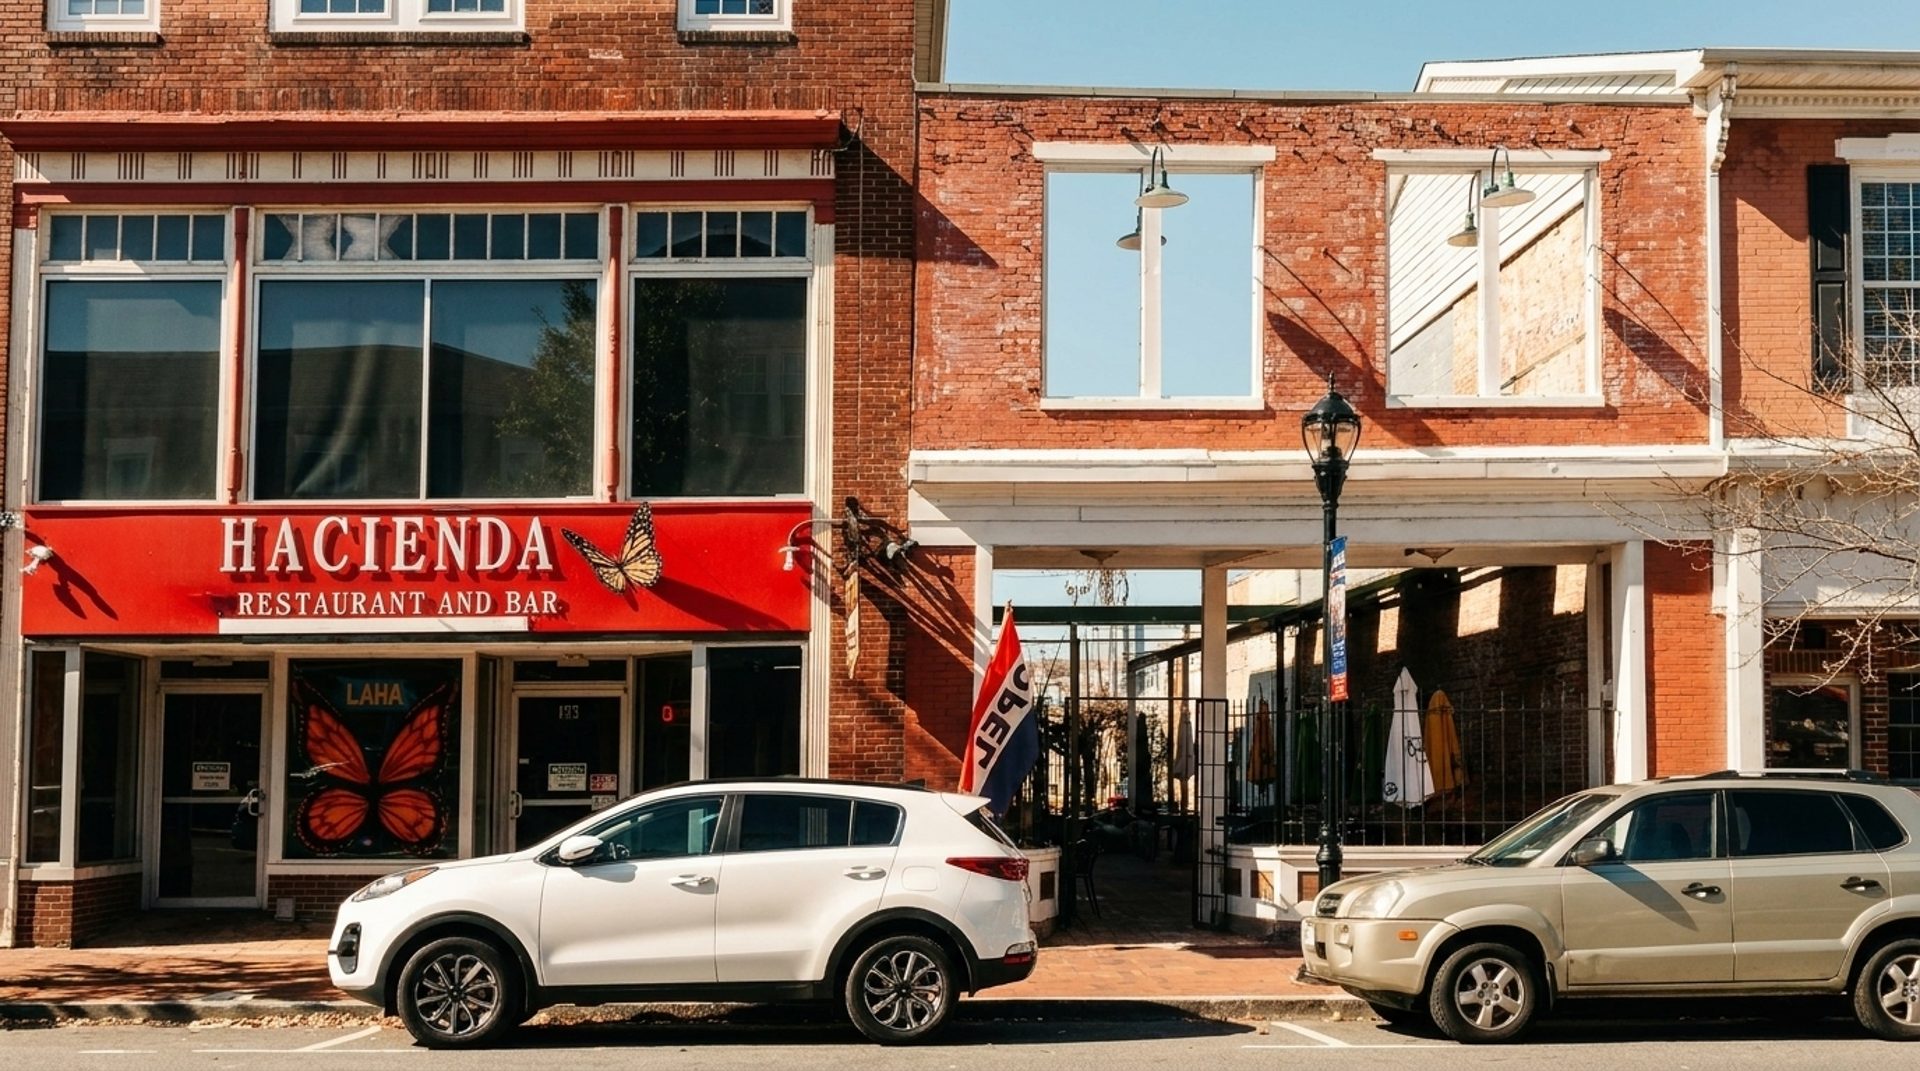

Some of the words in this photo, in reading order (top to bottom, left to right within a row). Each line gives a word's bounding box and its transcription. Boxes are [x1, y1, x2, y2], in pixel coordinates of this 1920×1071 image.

[220, 516, 553, 572] HACIENDA
[237, 592, 425, 616] RESTAURANT
[437, 592, 492, 615] AND
[504, 591, 559, 615] BAR
[347, 684, 404, 705] LAHA
